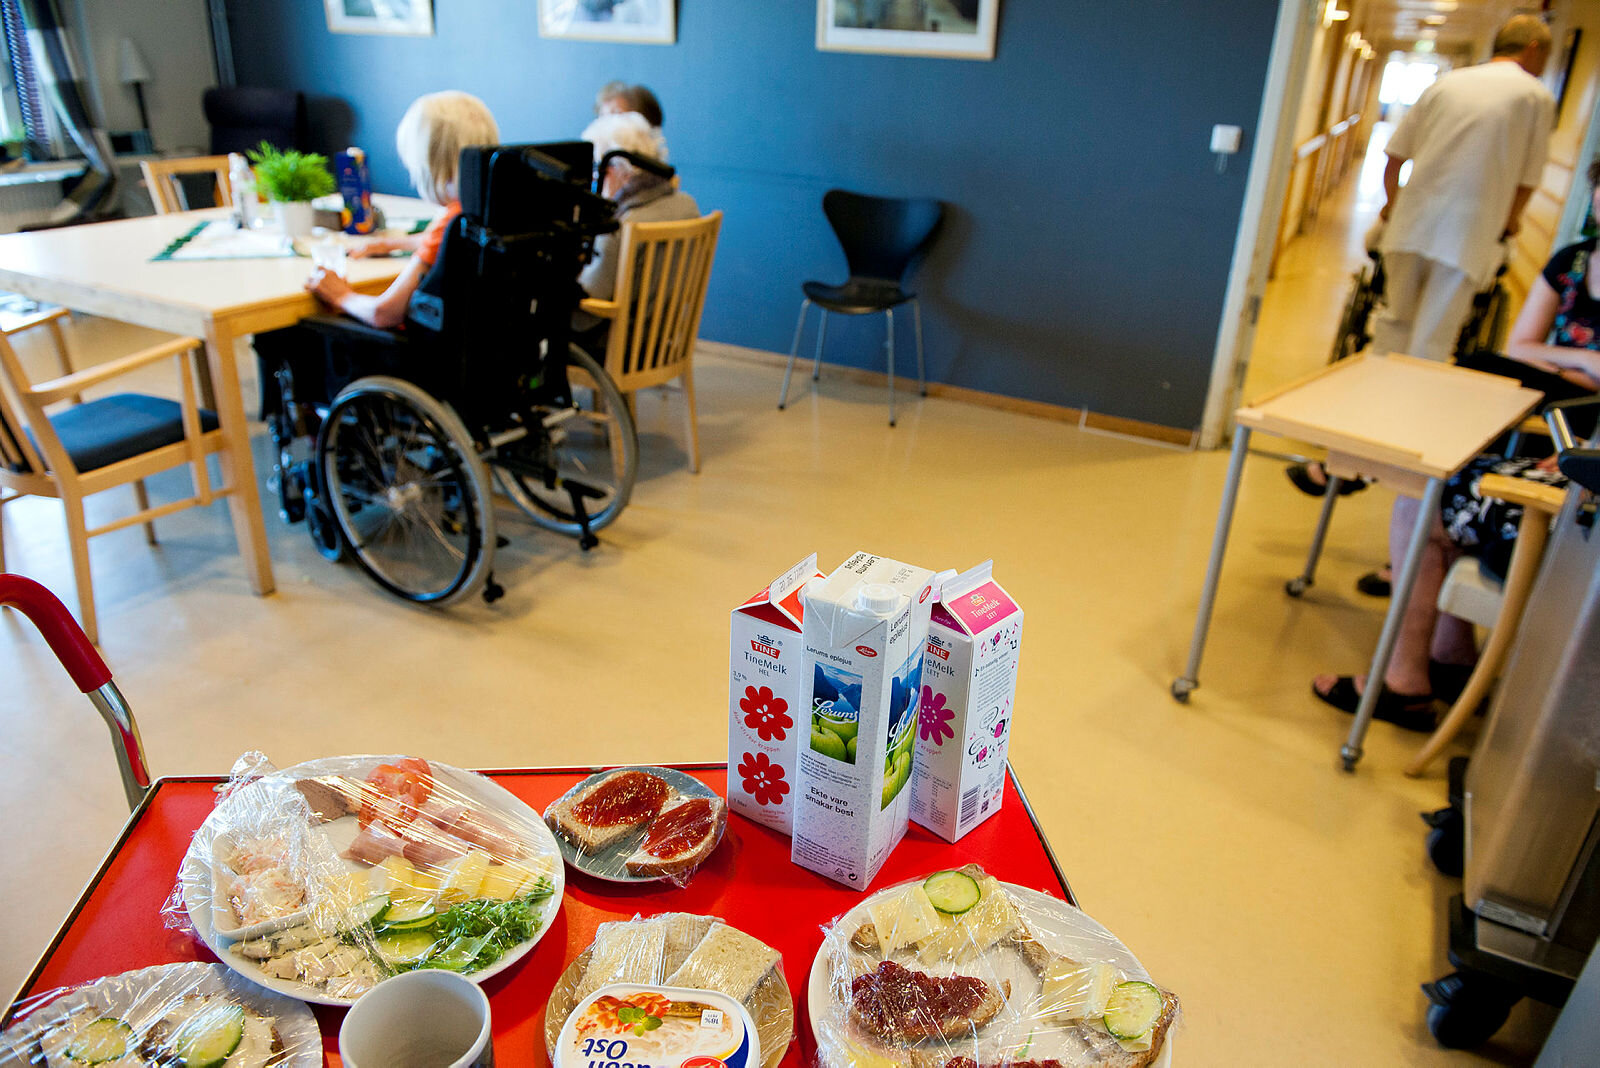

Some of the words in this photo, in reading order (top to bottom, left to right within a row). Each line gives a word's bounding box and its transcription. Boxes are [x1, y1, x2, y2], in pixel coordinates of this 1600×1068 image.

[753, 642, 778, 657] TINE
[806, 645, 829, 658] Lerums
[829, 654, 852, 666] eplejus
[928, 644, 948, 657] INE
[744, 651, 787, 675] TineMelk
[927, 659, 954, 677] eMelk
[812, 698, 858, 724] Lerums
[805, 794, 833, 810] smakar
[835, 806, 854, 817] best
[810, 786, 828, 800] Ekte
[830, 796, 848, 807] vare
[582, 1038, 628, 1060] Ost
